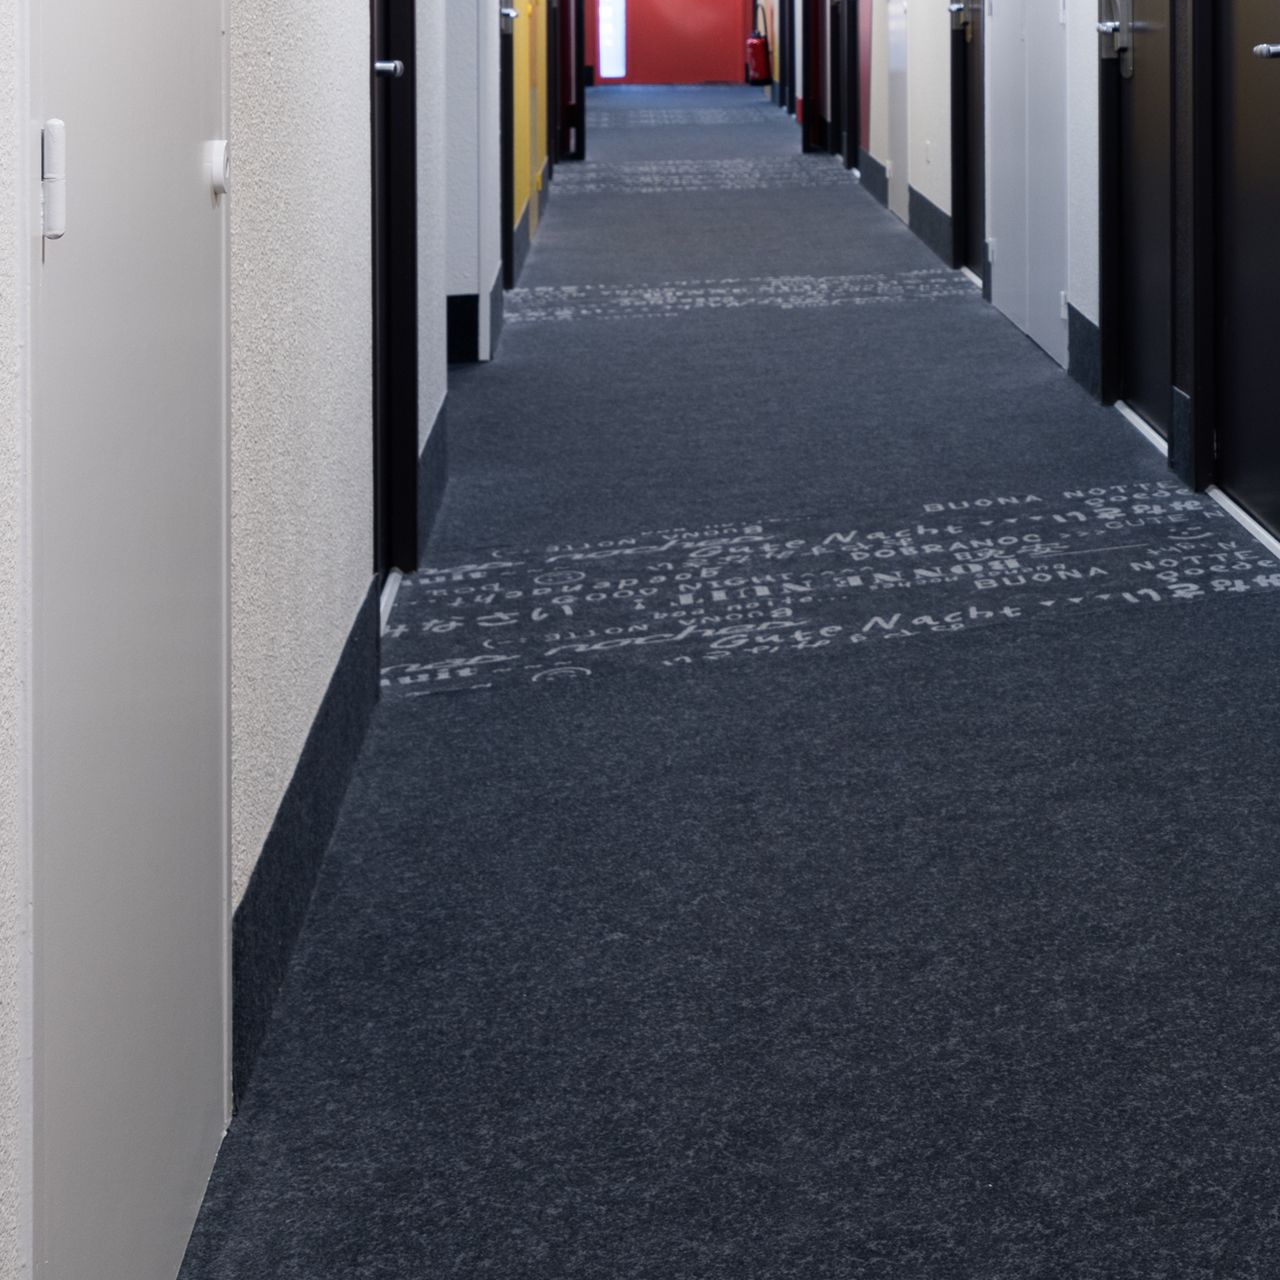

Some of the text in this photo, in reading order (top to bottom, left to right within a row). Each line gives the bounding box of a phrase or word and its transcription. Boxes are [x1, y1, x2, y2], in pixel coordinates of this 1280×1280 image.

[923, 480, 1179, 512] BUONA NOTTE
[688, 539, 806, 558] Gute
[822, 524, 963, 546] Nacht
[850, 534, 1042, 561] DOBRANOC
[974, 549, 1260, 590] BUONA NOTTE
[709, 606, 1022, 649] Gute Nacht
